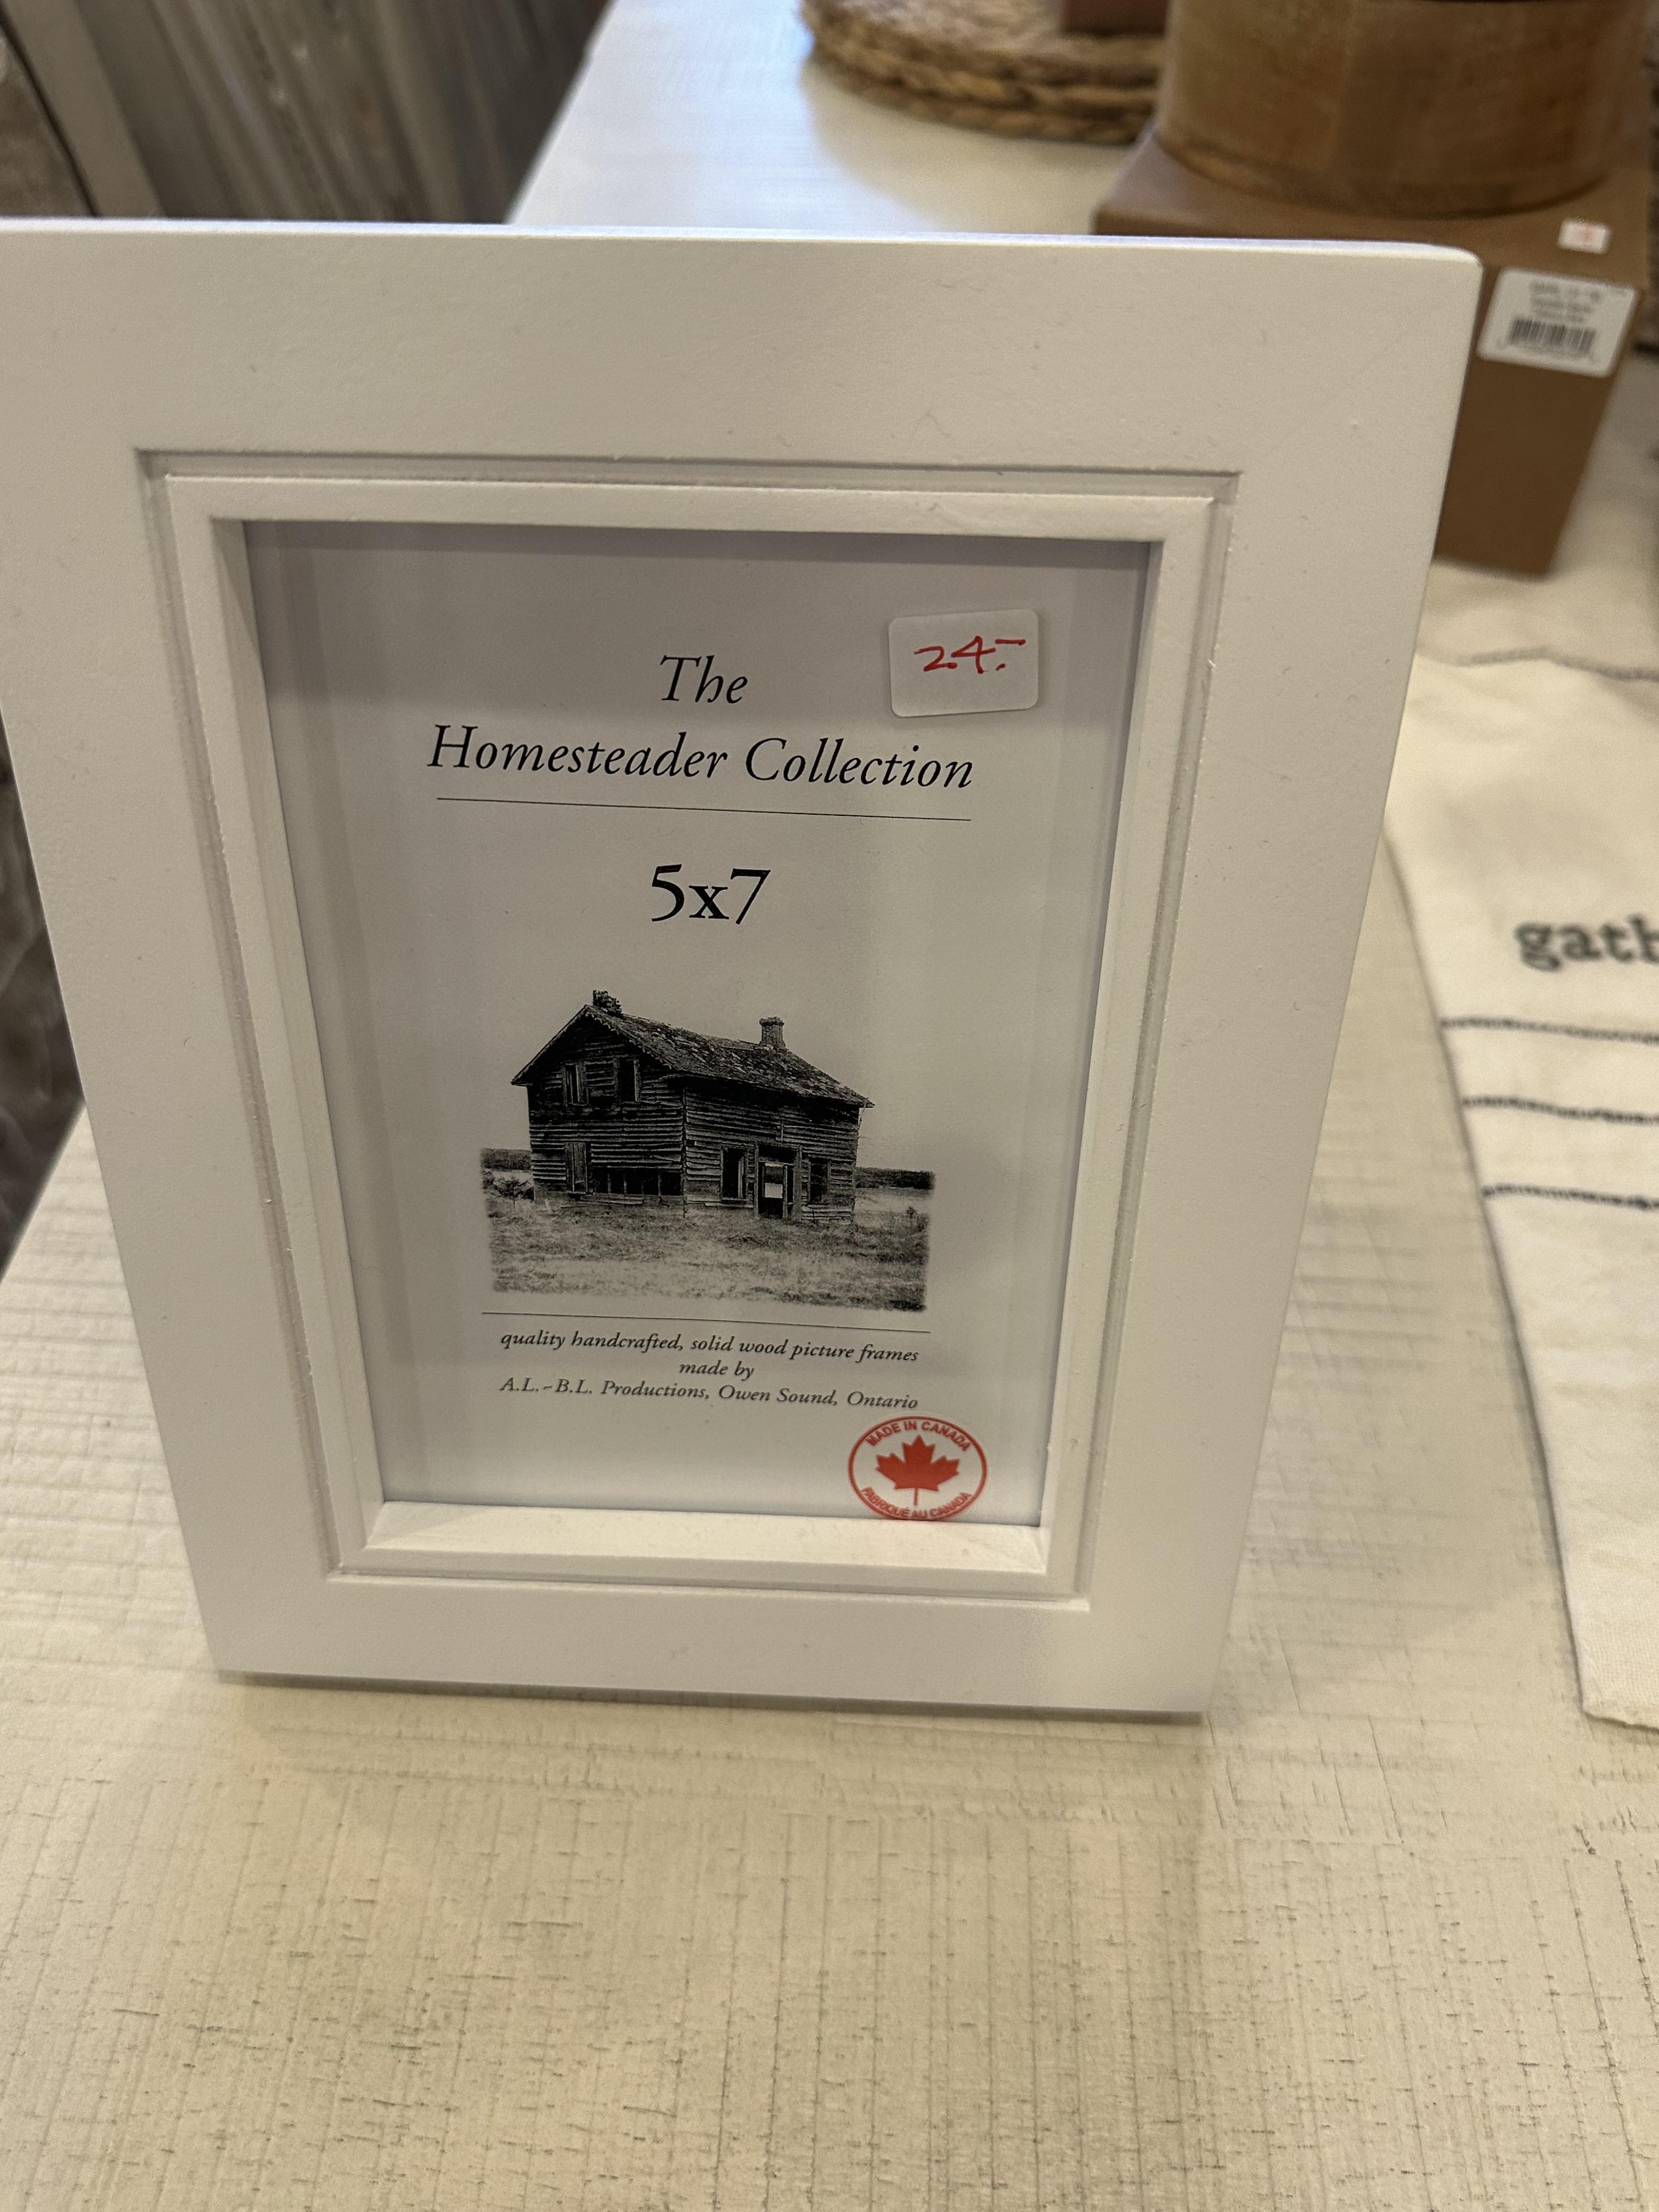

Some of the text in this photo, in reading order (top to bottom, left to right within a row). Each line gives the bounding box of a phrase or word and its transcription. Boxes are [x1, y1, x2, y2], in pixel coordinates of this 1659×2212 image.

[659, 654, 749, 704] The
[426, 724, 973, 789] Homesteader Collection
[651, 864, 771, 925] 5x7
[500, 1329, 919, 1364] quality handcrafted, solid wood picture frames
[679, 1359, 755, 1382] made by
[600, 1380, 709, 1401] Productions,
[718, 1384, 771, 1402] Owen
[776, 1387, 838, 1407] Sound,
[847, 1391, 918, 1409] Ontario
[865, 1421, 972, 1452] MADE IN CANADA
[929, 1492, 972, 1517] CANADA
